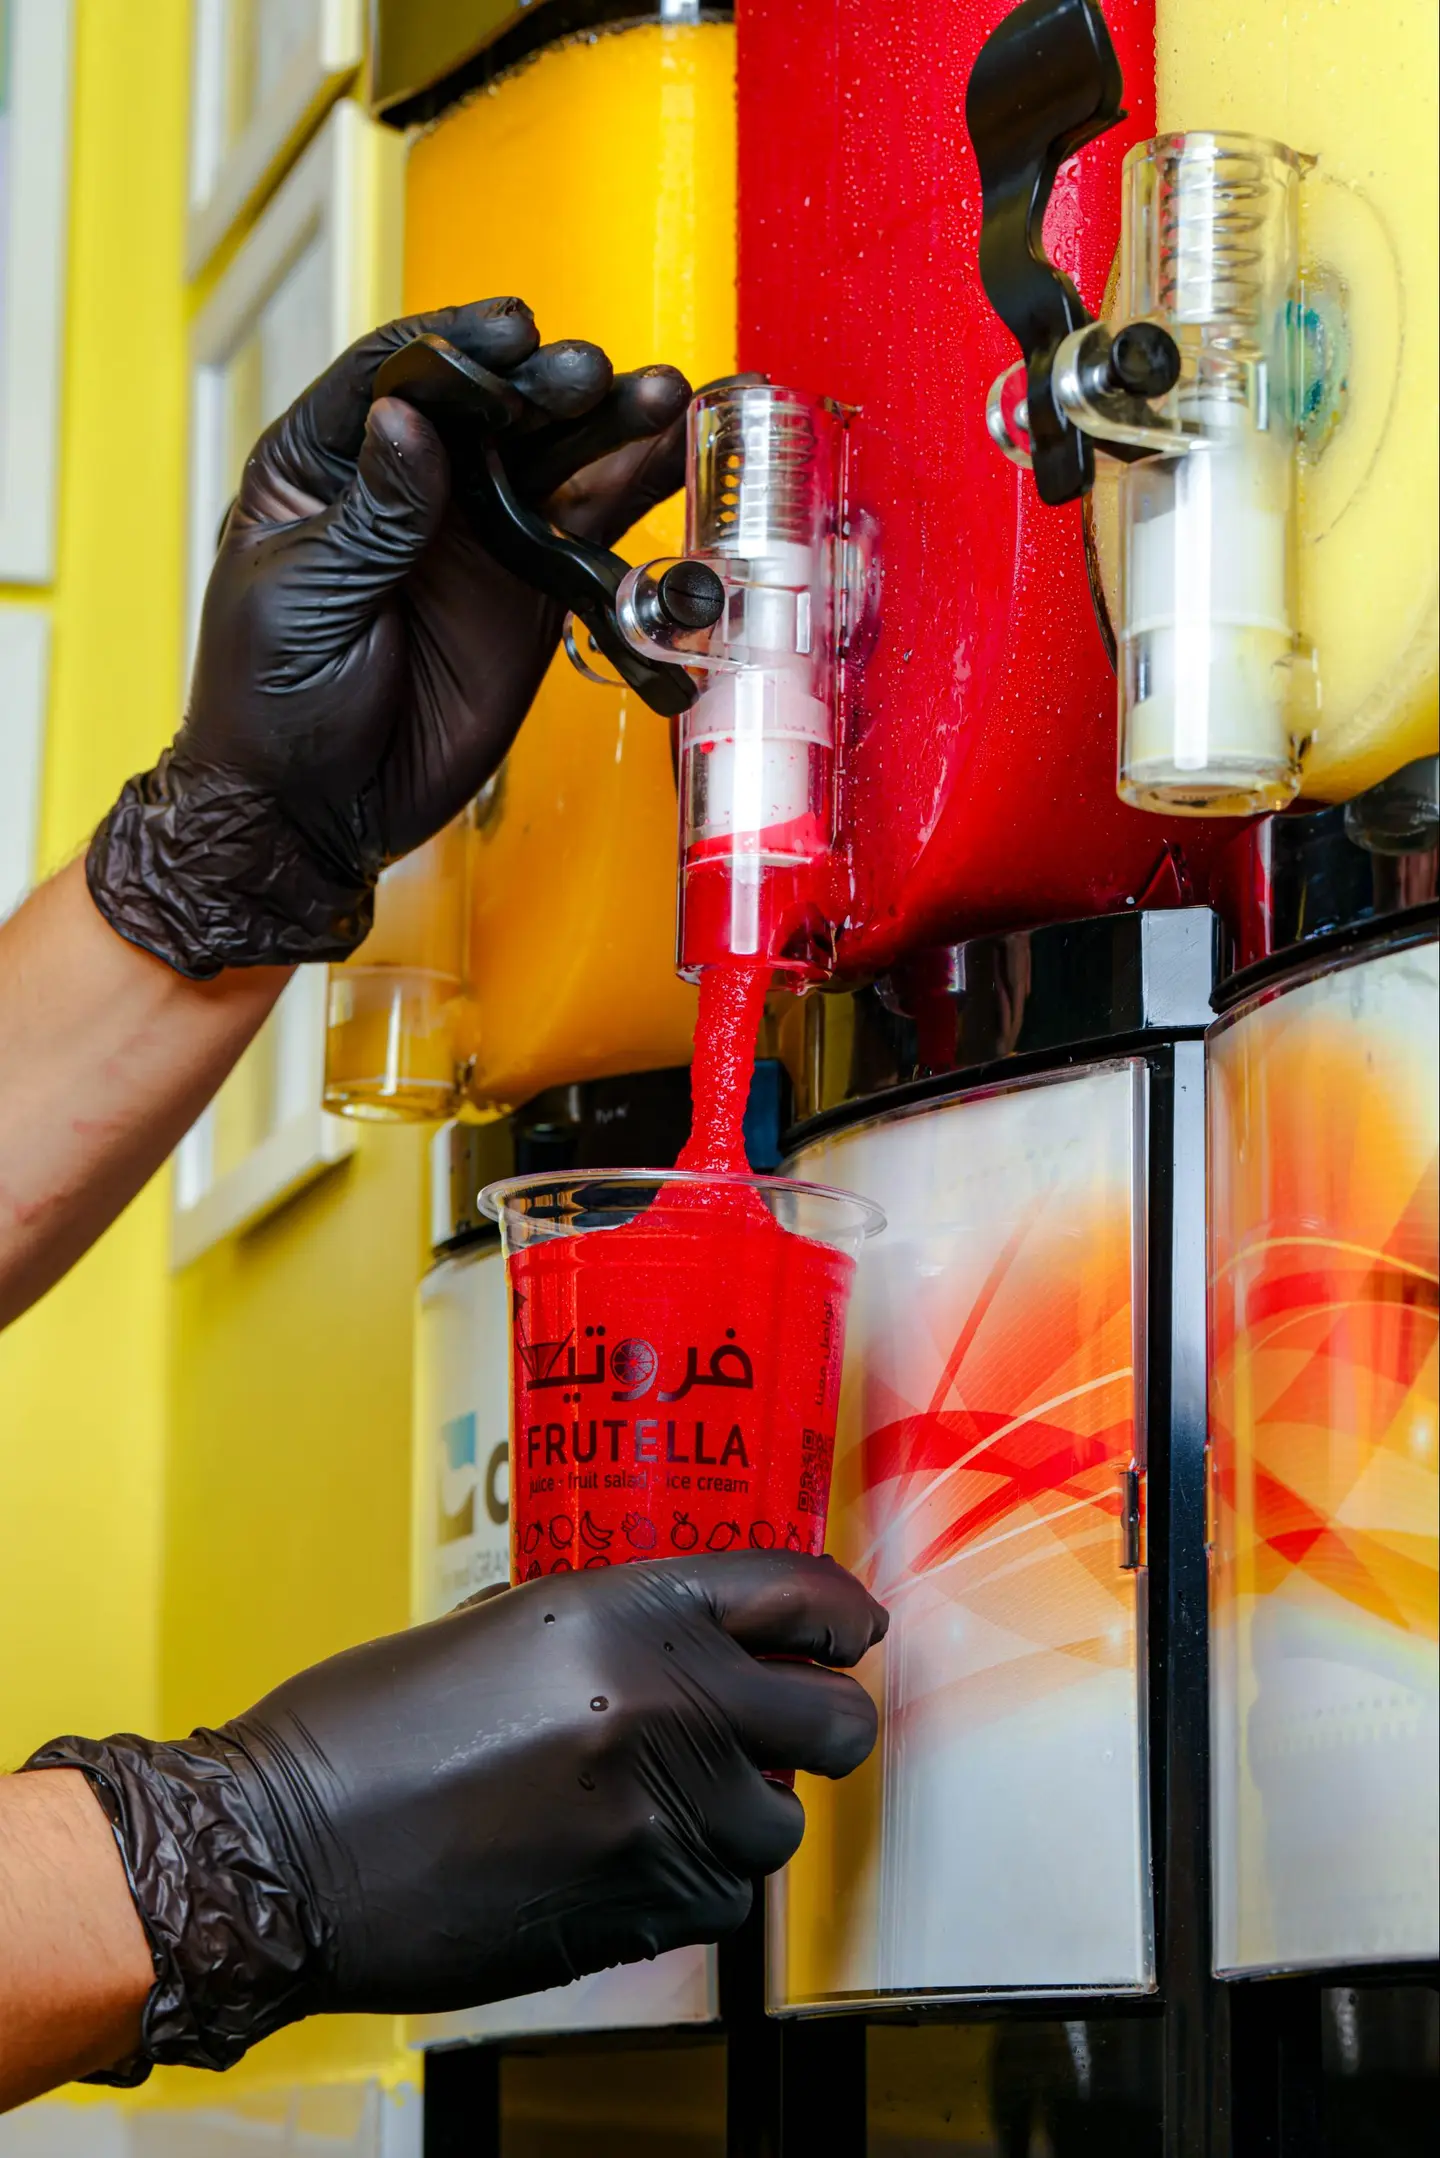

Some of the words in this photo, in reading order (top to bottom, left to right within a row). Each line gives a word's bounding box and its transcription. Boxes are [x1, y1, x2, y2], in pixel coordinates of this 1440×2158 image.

[527, 1420, 750, 1469] FRUTELLA
[529, 1474, 555, 1499] juice
[567, 1472, 599, 1490] fruit
[604, 1470, 647, 1490] salad
[666, 1474, 691, 1490] ice
[697, 1475, 749, 1494] cream
